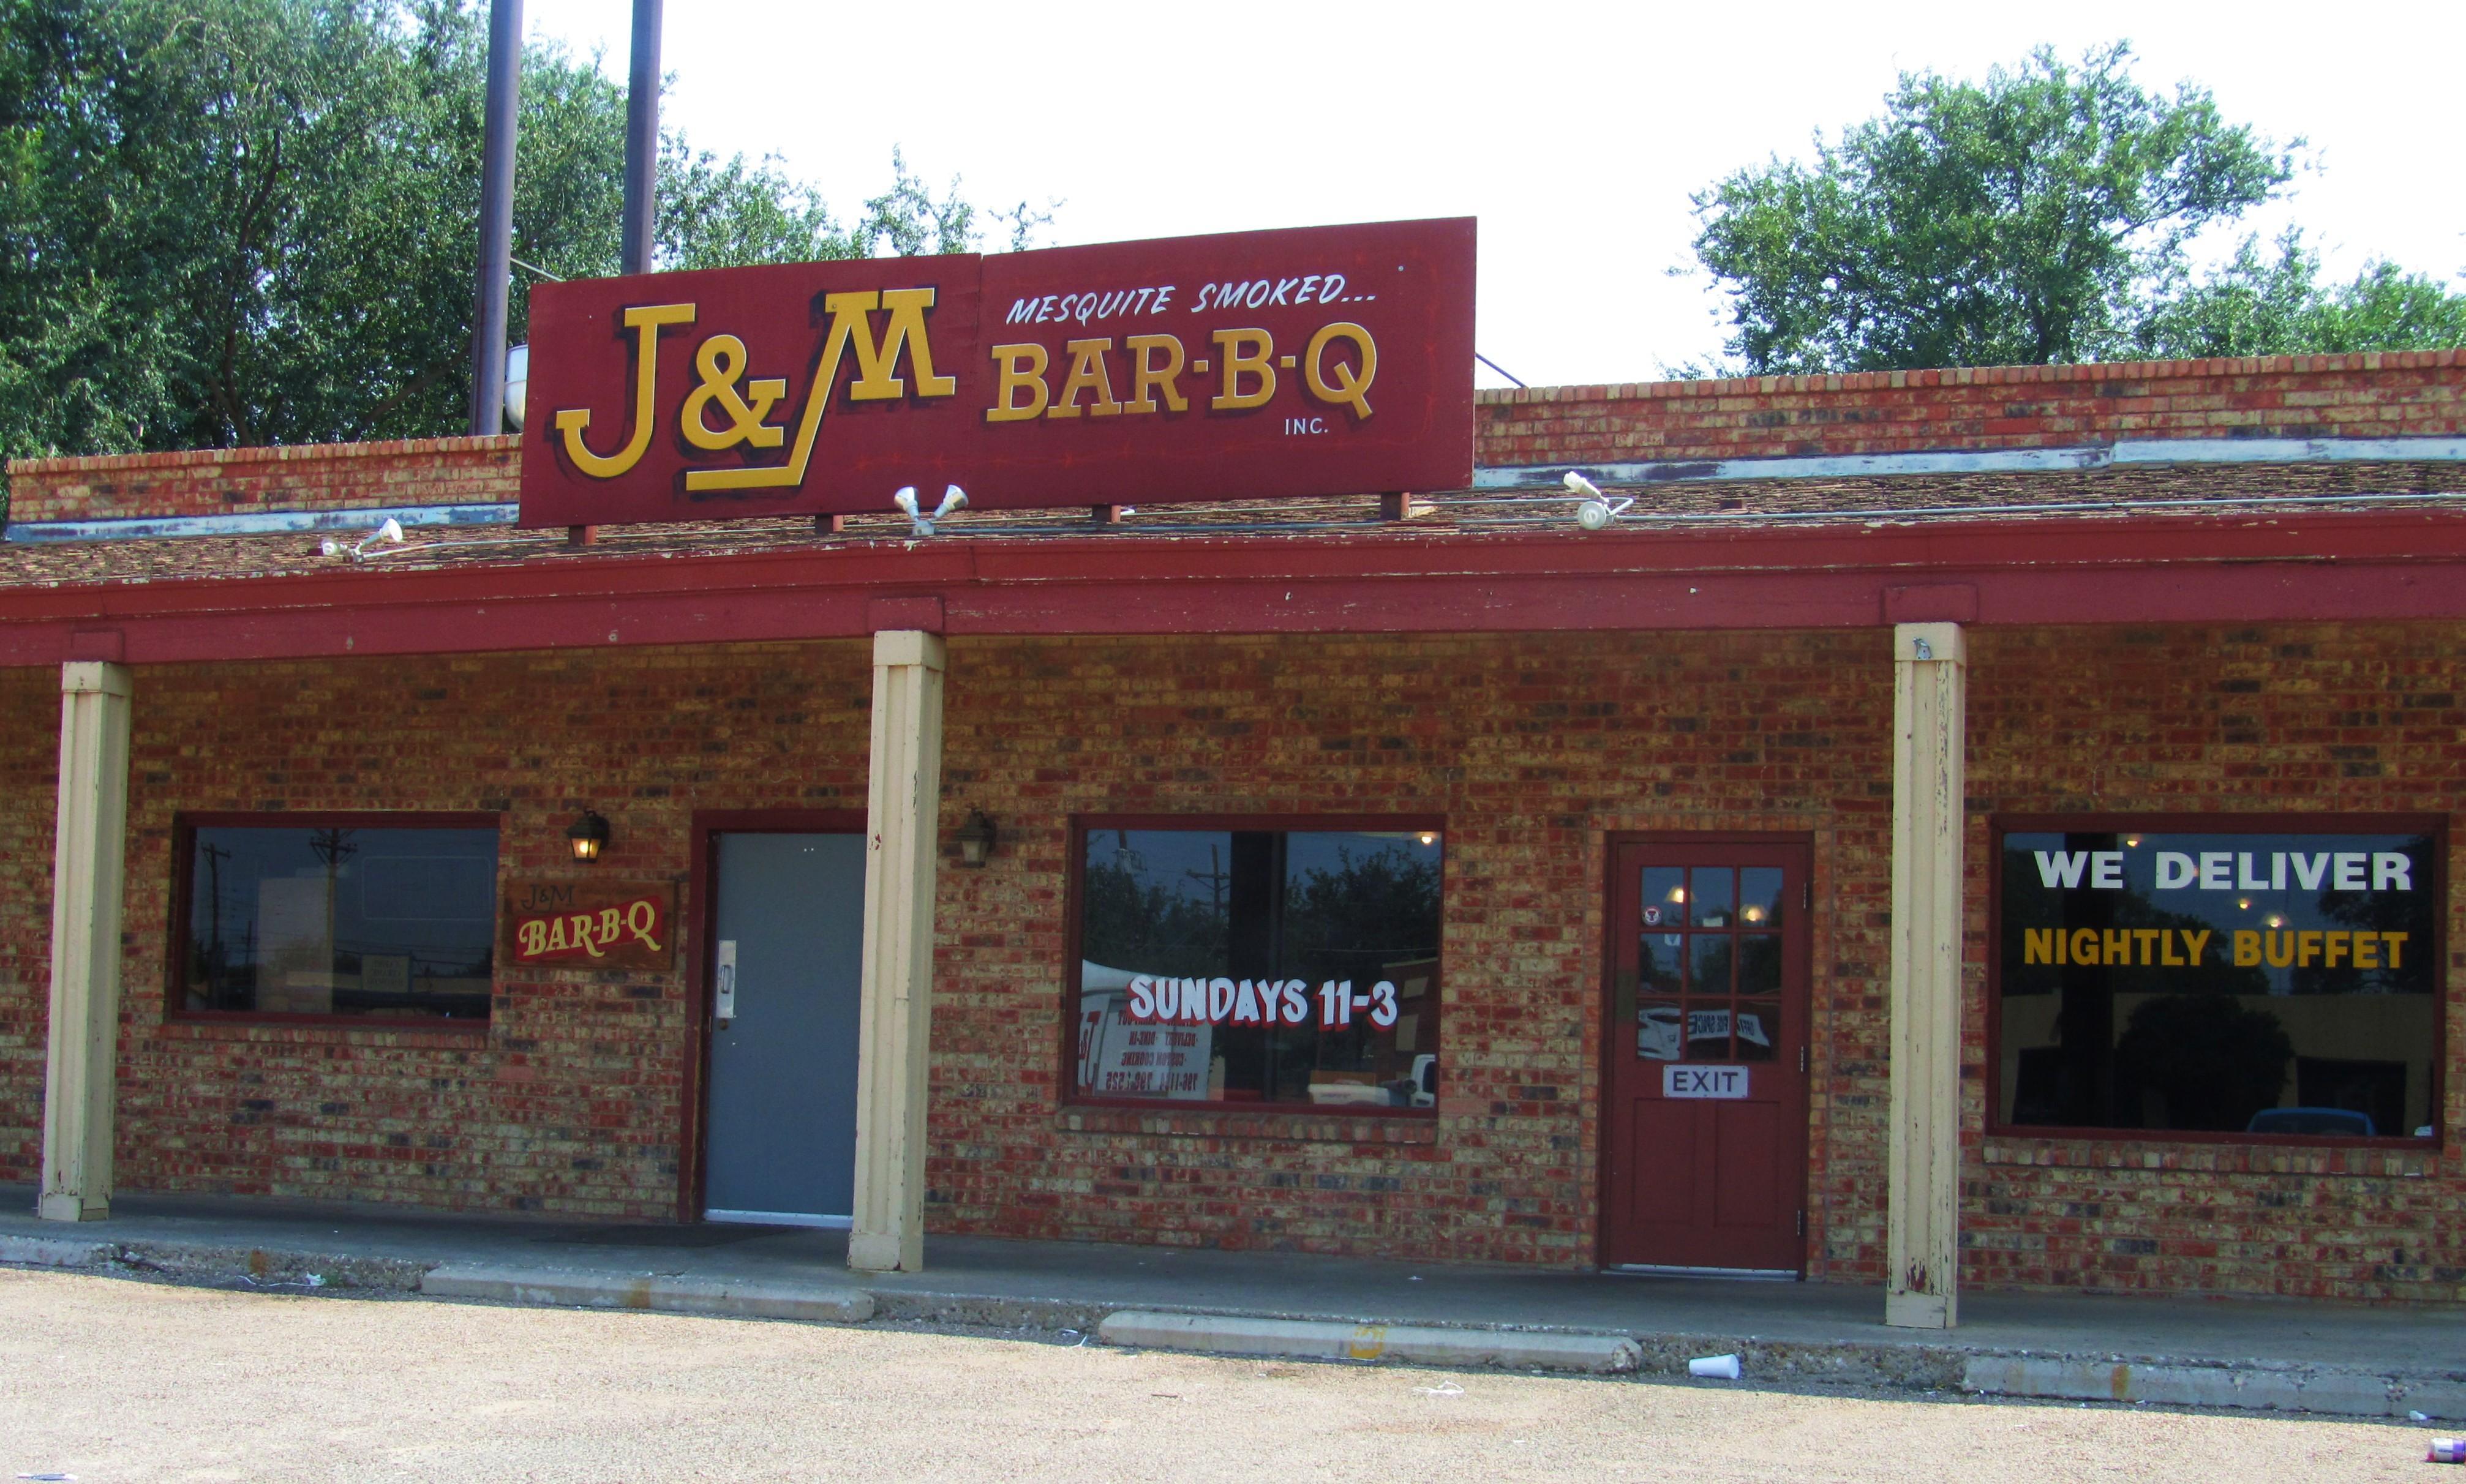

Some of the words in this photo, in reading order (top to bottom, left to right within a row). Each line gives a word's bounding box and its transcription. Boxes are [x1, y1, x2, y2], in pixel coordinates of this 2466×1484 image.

[1006, 285, 1176, 326] MESQUITE
[555, 287, 956, 491] J&M
[987, 321, 1377, 421] BAR-B-Q
[1284, 417, 1329, 435] INC.
[2034, 850, 2124, 889] WE
[2155, 852, 2412, 891] DELIVER
[522, 885, 574, 910] J&M
[519, 901, 662, 957] BAR-B-Q
[2024, 928, 2211, 967] NIGHTLY
[2234, 929, 2408, 969] BUFFET
[1127, 975, 1309, 1029] SUNDAYS
[1314, 980, 1398, 1031] 11-3
[1673, 1071, 1739, 1092] EXIT
